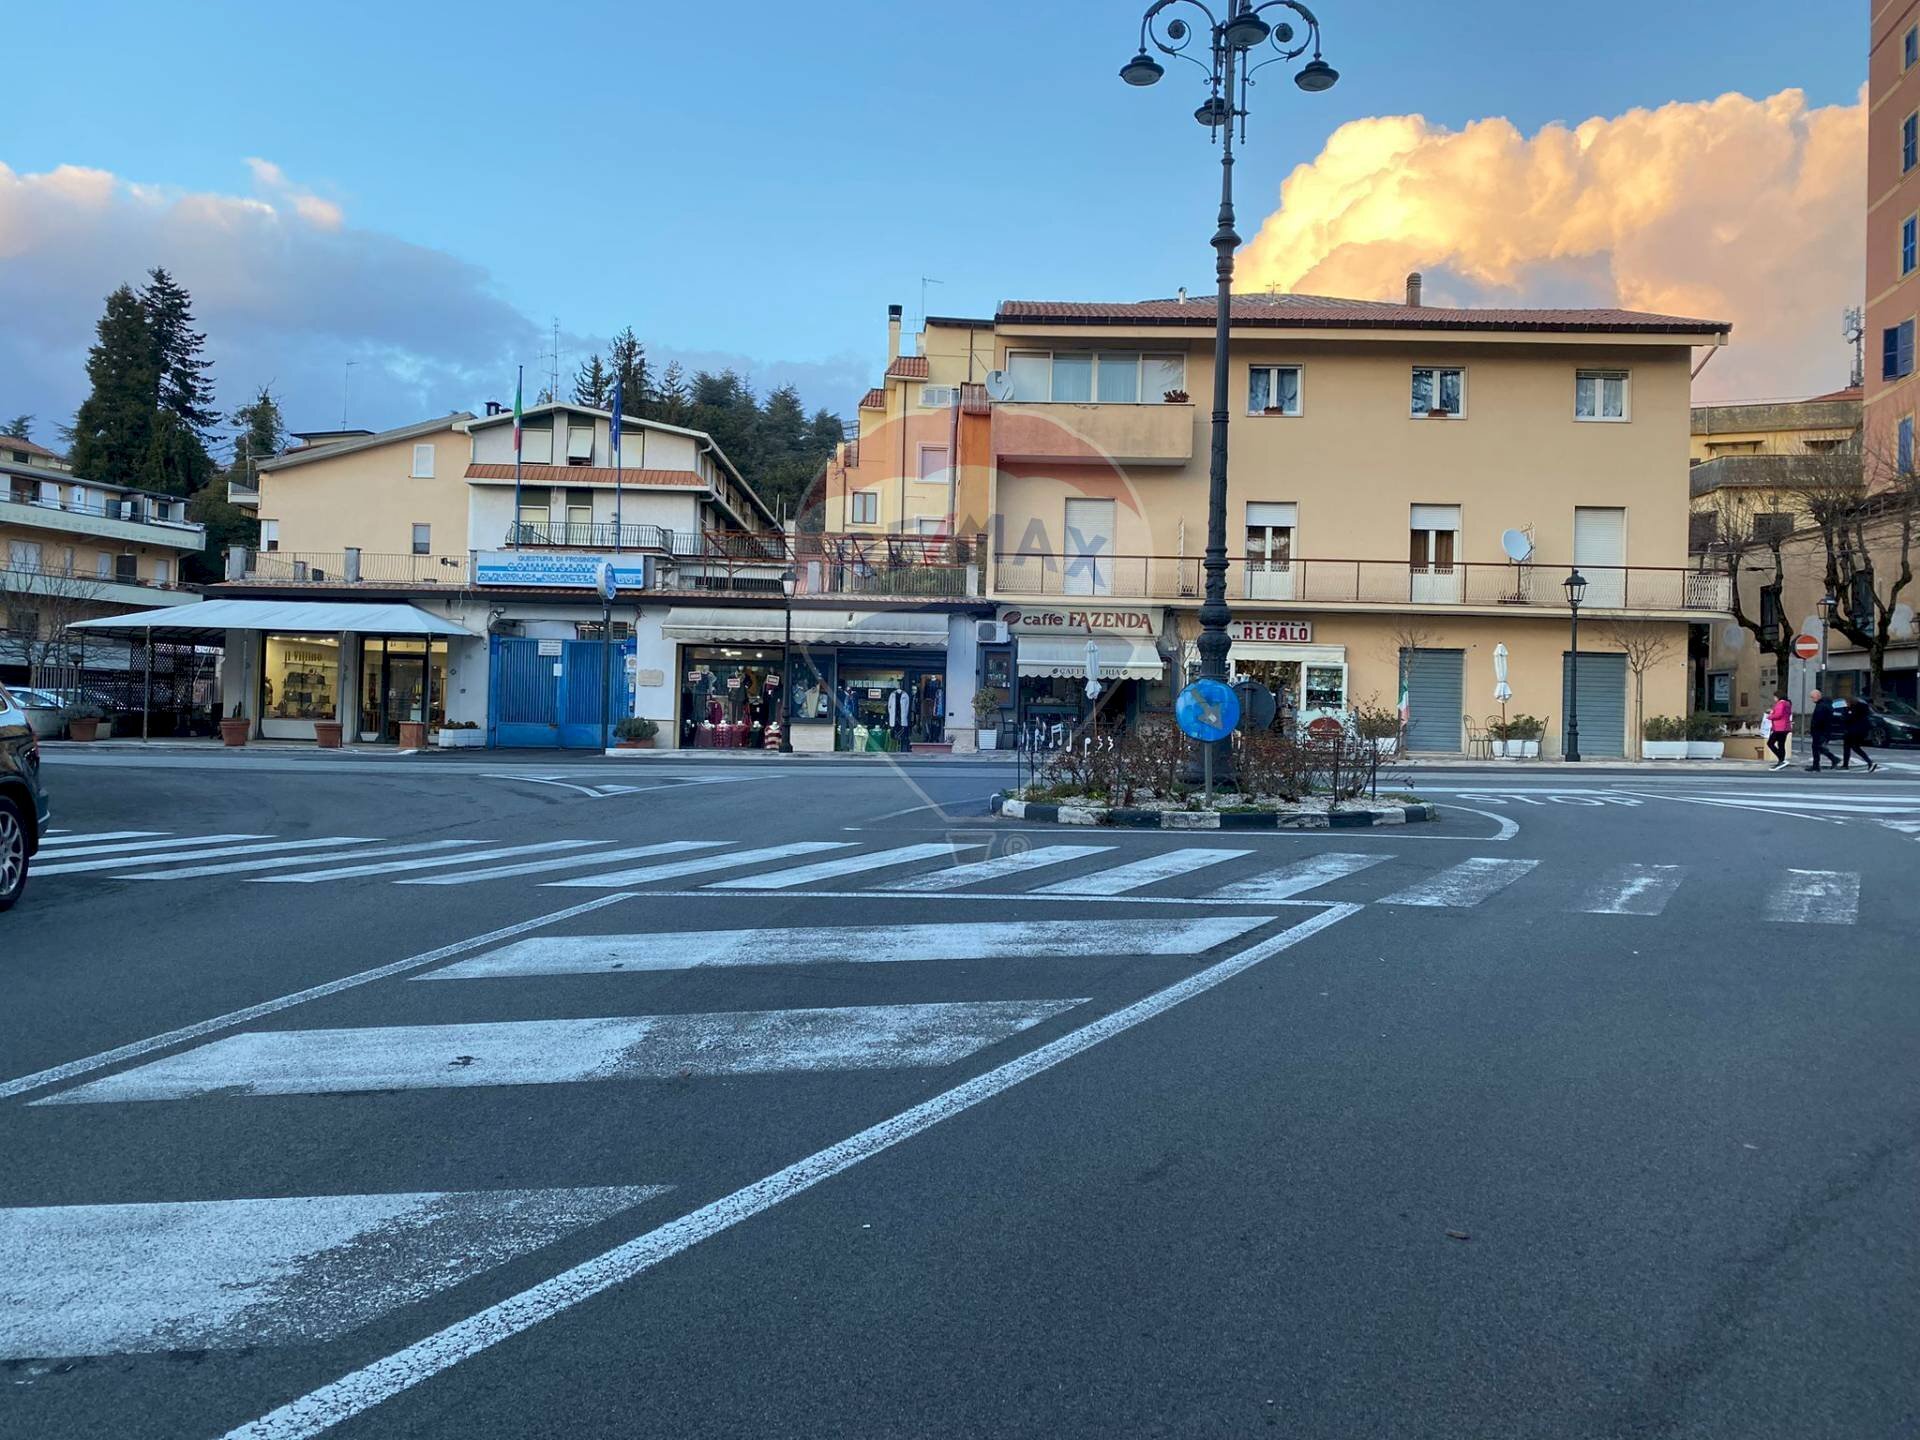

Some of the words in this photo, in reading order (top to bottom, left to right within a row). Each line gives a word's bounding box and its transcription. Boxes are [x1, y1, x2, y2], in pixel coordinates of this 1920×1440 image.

[508, 562, 598, 572] COMMISSARIA
[480, 573, 489, 581] DI
[491, 573, 537, 582] PUBBLICA
[542, 574, 594, 583] SICUREZZA
[1068, 611, 1153, 634] FAZENDA
[1243, 626, 1308, 641] REGALO
[1456, 793, 1645, 807] STOP
